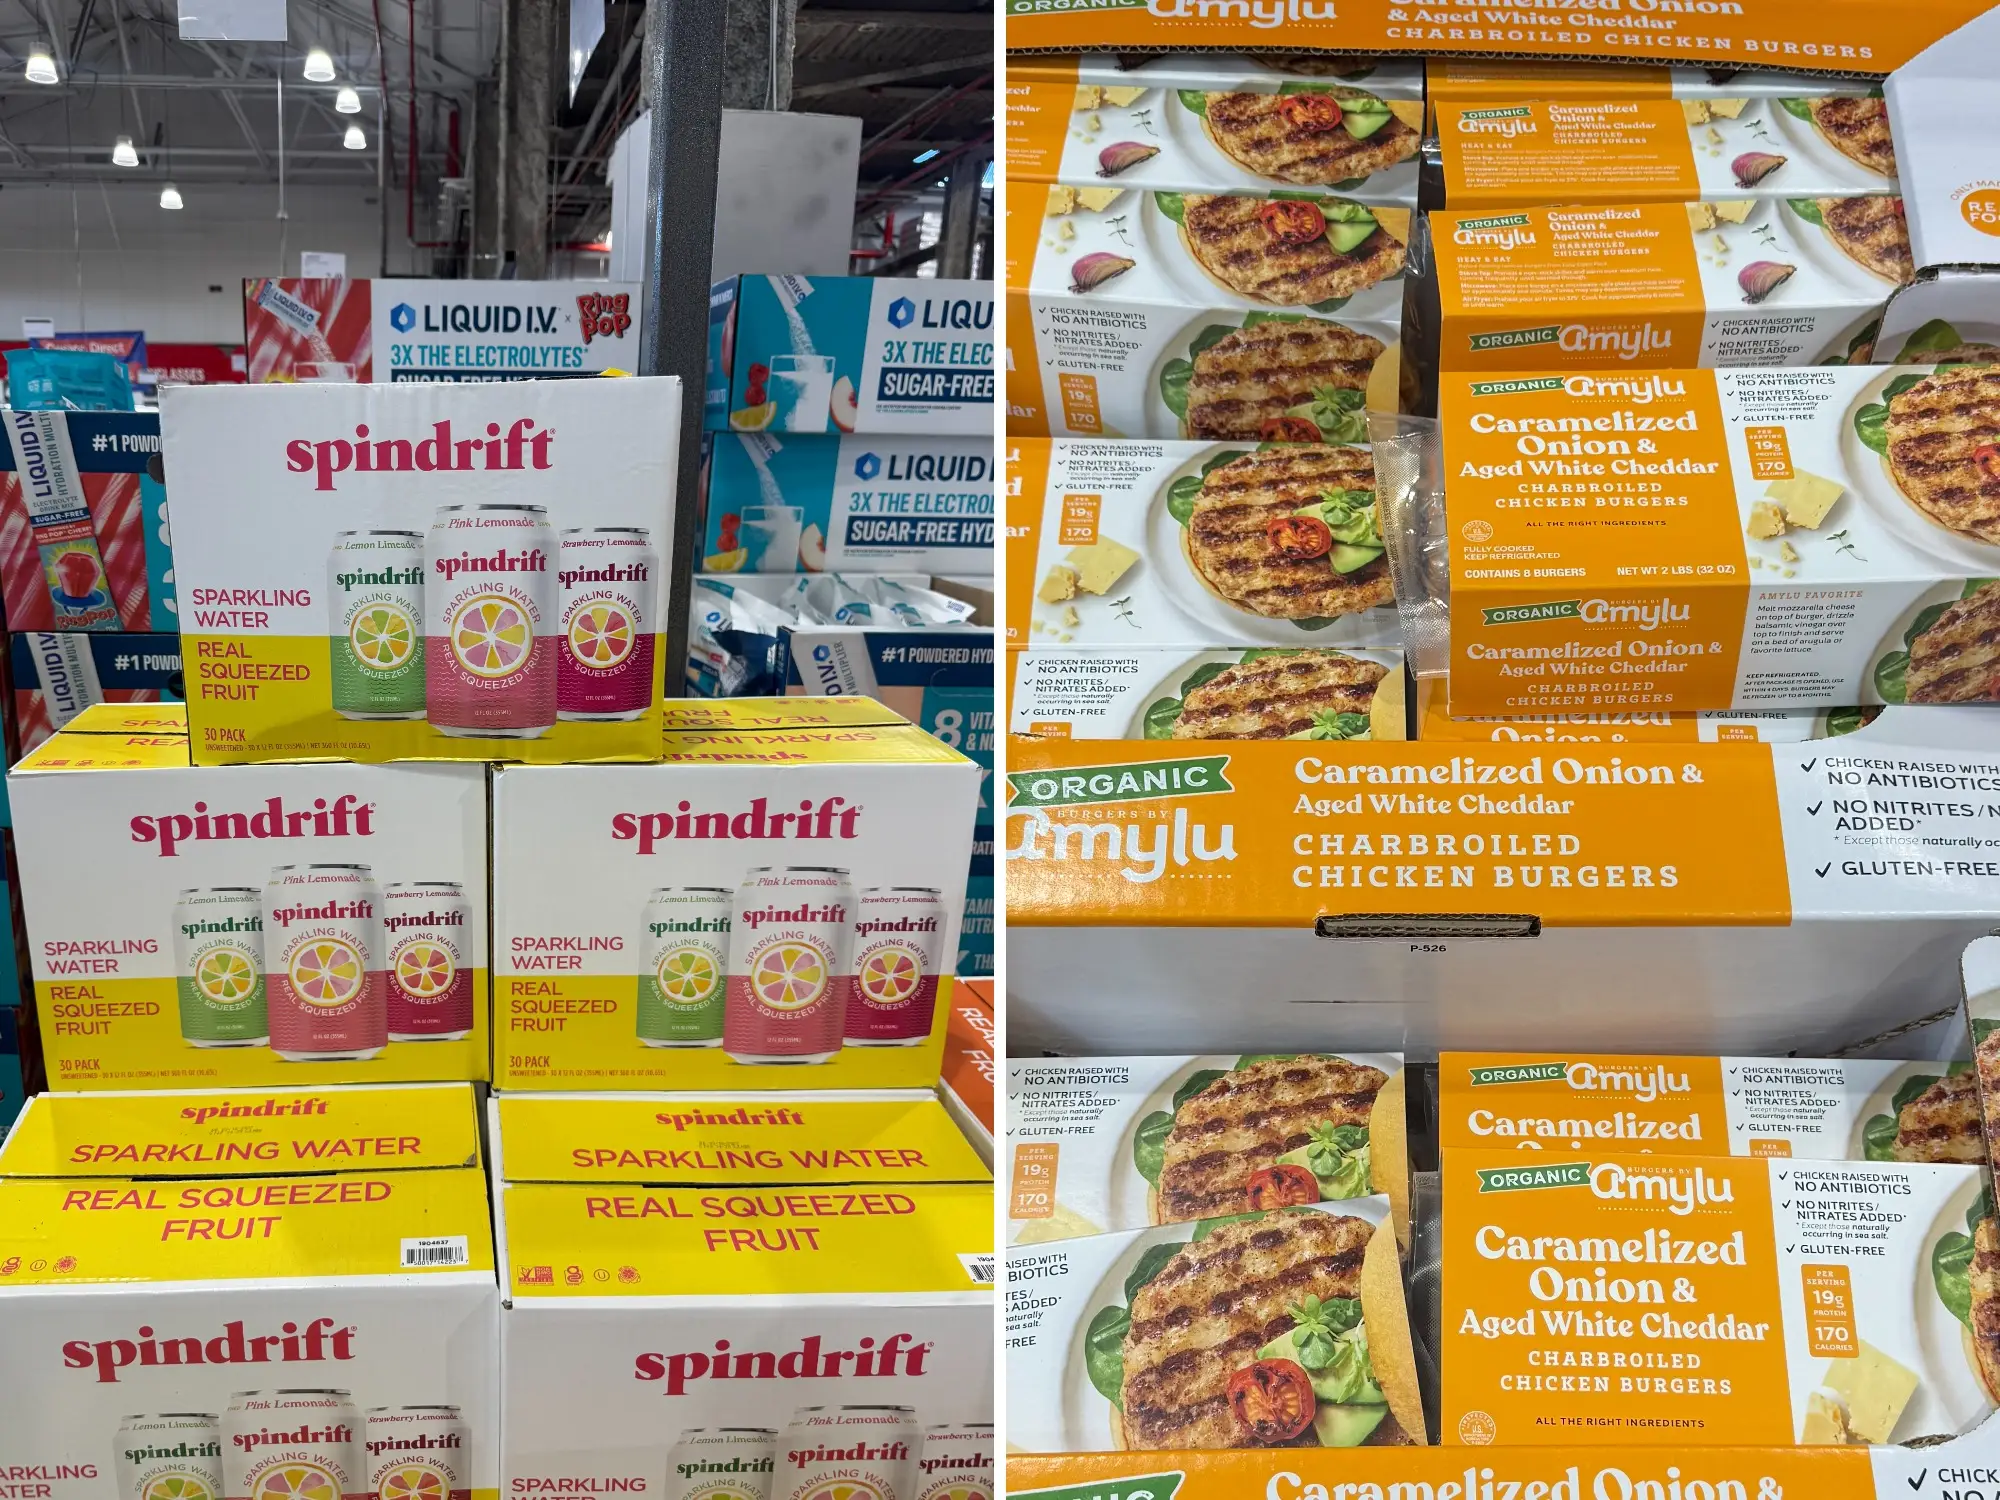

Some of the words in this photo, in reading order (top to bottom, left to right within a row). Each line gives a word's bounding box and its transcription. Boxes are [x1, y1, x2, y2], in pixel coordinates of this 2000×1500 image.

[1387, 10, 1407, 22] &
[1413, 10, 1479, 28] Aged
[1484, 11, 1563, 27] White
[1568, 13, 1677, 30] Cheddar
[1386, 27, 1592, 43] CHARBROILED
[1605, 33, 1731, 49] CHICKEN
[1744, 40, 1873, 59] BURGERS
[1464, 216, 1523, 229] ORGANIC
[1547, 208, 1641, 221] Caramelized
[1549, 220, 1595, 231] Onion
[1453, 229, 1537, 250] amylu
[425, 304, 519, 334] LIQUID
[526, 305, 557, 333] I.V.
[391, 345, 412, 366] 3X
[418, 345, 450, 366] THE
[882, 341, 906, 364] 3X
[911, 342, 945, 364] THE
[884, 373, 992, 397] SUGAR-FREE
[1480, 379, 1557, 393] ORGANIC
[1564, 375, 1687, 404] amylu
[1470, 410, 1699, 434] Caramelized
[92, 435, 118, 452] #1
[122, 435, 162, 452] POWD
[1516, 434, 1631, 456] Onion
[1636, 438, 1658, 454] &
[22, 430, 53, 497] LIQUID
[48, 444, 69, 496] HYDRATION
[888, 454, 985, 482] LIQUID
[1459, 460, 1523, 479] Aged
[1527, 459, 1605, 476] White
[1611, 458, 1719, 476] Cheddar
[1518, 482, 1663, 493] CHARBROILED
[849, 492, 870, 513] 3X
[877, 492, 909, 513] THE
[1495, 497, 1587, 509] CHICKEN
[1595, 496, 1689, 508] BURGERS
[34, 509, 85, 524] SUGAR-FREE
[448, 518, 473, 529] Pink
[475, 517, 535, 529] Lemonade
[851, 521, 956, 543] SUGAR-FREE
[345, 540, 375, 550] Lemon
[377, 540, 415, 550] Limeade
[561, 539, 605, 550] Strawberry
[606, 538, 647, 548] Lemonade
[435, 549, 547, 580] spindrift
[1464, 569, 1521, 578] CONTAINS
[1523, 569, 1531, 578] 8
[1533, 568, 1586, 577] BURGERS
[1616, 566, 1638, 576] NET
[1640, 566, 1658, 576] WT
[1661, 566, 1669, 575] 2
[1671, 565, 1694, 575] LBS
[1696, 564, 1714, 575] (32
[1716, 564, 1736, 575] OZ)
[337, 566, 425, 591] spindrift
[558, 563, 649, 589] spindrift
[192, 588, 311, 607] SPARKLING
[442, 582, 504, 625] SPARKLING
[508, 585, 541, 625] WATER
[1758, 592, 1801, 600] AMYLU
[1804, 590, 1864, 599] FAVORITE
[1492, 604, 1572, 621] ORGANIC
[1580, 597, 1690, 631] amylu
[1825, 603, 1856, 611] cheese
[194, 611, 270, 628] WATER
[197, 642, 252, 660] REAL
[882, 647, 906, 663] #1
[909, 648, 968, 665] POWDERED
[199, 663, 311, 682] SQUEEZED
[202, 684, 259, 701] FRUIT
[204, 728, 217, 742] 30
[219, 727, 246, 742] PACK
[1293, 756, 1545, 786] Caramelized
[1552, 756, 1676, 786] Onion
[1681, 763, 1705, 784] &
[1824, 757, 1894, 770] CHICKEN
[1898, 761, 1956, 773] RAISED
[1958, 764, 2000, 775] WITH
[1031, 766, 1209, 801] ORGANIC
[1827, 771, 1862, 785] NO
[1293, 793, 1362, 817] Aged
[1367, 793, 1452, 815] White
[1458, 793, 1574, 815] Cheddar
[1293, 833, 1581, 857] CHARBROILED
[1292, 865, 1475, 888] CHICKEN
[1493, 865, 1679, 888] BURGERS
[1841, 861, 2000, 876] GLUTEN-FREE
[44, 938, 158, 957] SPARKLING
[511, 936, 624, 952] SPARKLING
[1409, 944, 1448, 953] P-526
[46, 958, 119, 975] WATER
[512, 955, 582, 970] WATER
[50, 985, 104, 1001] REAL
[511, 982, 563, 996] REAL
[53, 1002, 160, 1019] SQUEEZED
[510, 999, 618, 1016] SQUEEZED
[56, 1021, 112, 1036] FRUIT
[511, 1018, 566, 1032] FRUIT
[59, 1059, 72, 1071] 30
[74, 1058, 101, 1071] PACK
[508, 1056, 522, 1068] 30
[525, 1056, 551, 1068] PACK
[180, 1098, 329, 1125] spindrift
[69, 1141, 280, 1163] SPARKLING
[292, 1136, 421, 1159] WATER
[1489, 1168, 1581, 1188] ORGANIC
[1793, 1171, 1840, 1182] CHICKEN
[1841, 1172, 1881, 1183] RAISED
[1882, 1173, 1909, 1184] WITH
[61, 1189, 167, 1211] REAL
[177, 1181, 391, 1209] SQUEEZED
[1589, 1162, 1735, 1216] amylu
[1794, 1181, 1817, 1193] NO
[1819, 1182, 1912, 1196] ANTIBIOTICS
[1796, 1200, 1816, 1211] NO
[1818, 1201, 1880, 1212] NITRITES/
[1796, 1211, 1858, 1222] NITRATES
[161, 1216, 282, 1242] FRUIT
[1852, 1223, 1890, 1233] naturally
[1475, 1225, 1747, 1266] Caramelized
[1800, 1244, 1886, 1257] GLUTEN-FREE
[1529, 1266, 1668, 1304] Onion
[1672, 1277, 1698, 1304] &
[1812, 1289, 1845, 1309] 19g
[1813, 1309, 1847, 1317] PROTEIN
[1459, 1308, 1536, 1340] Aged
[1540, 1310, 1635, 1339] White
[1640, 1311, 1770, 1341] Cheddar
[1815, 1326, 1848, 1342] 170
[1815, 1343, 1853, 1351] CALORIES
[1528, 1350, 1701, 1370] CHARBROILED
[1500, 1374, 1610, 1392] CHICKEN
[1619, 1376, 1732, 1395] BURGERS
[1535, 1416, 1557, 1426] ALL
[1559, 1417, 1583, 1426] THE
[1586, 1417, 1622, 1427] RIGHT
[1625, 1418, 1705, 1429] INGREDIENTS
